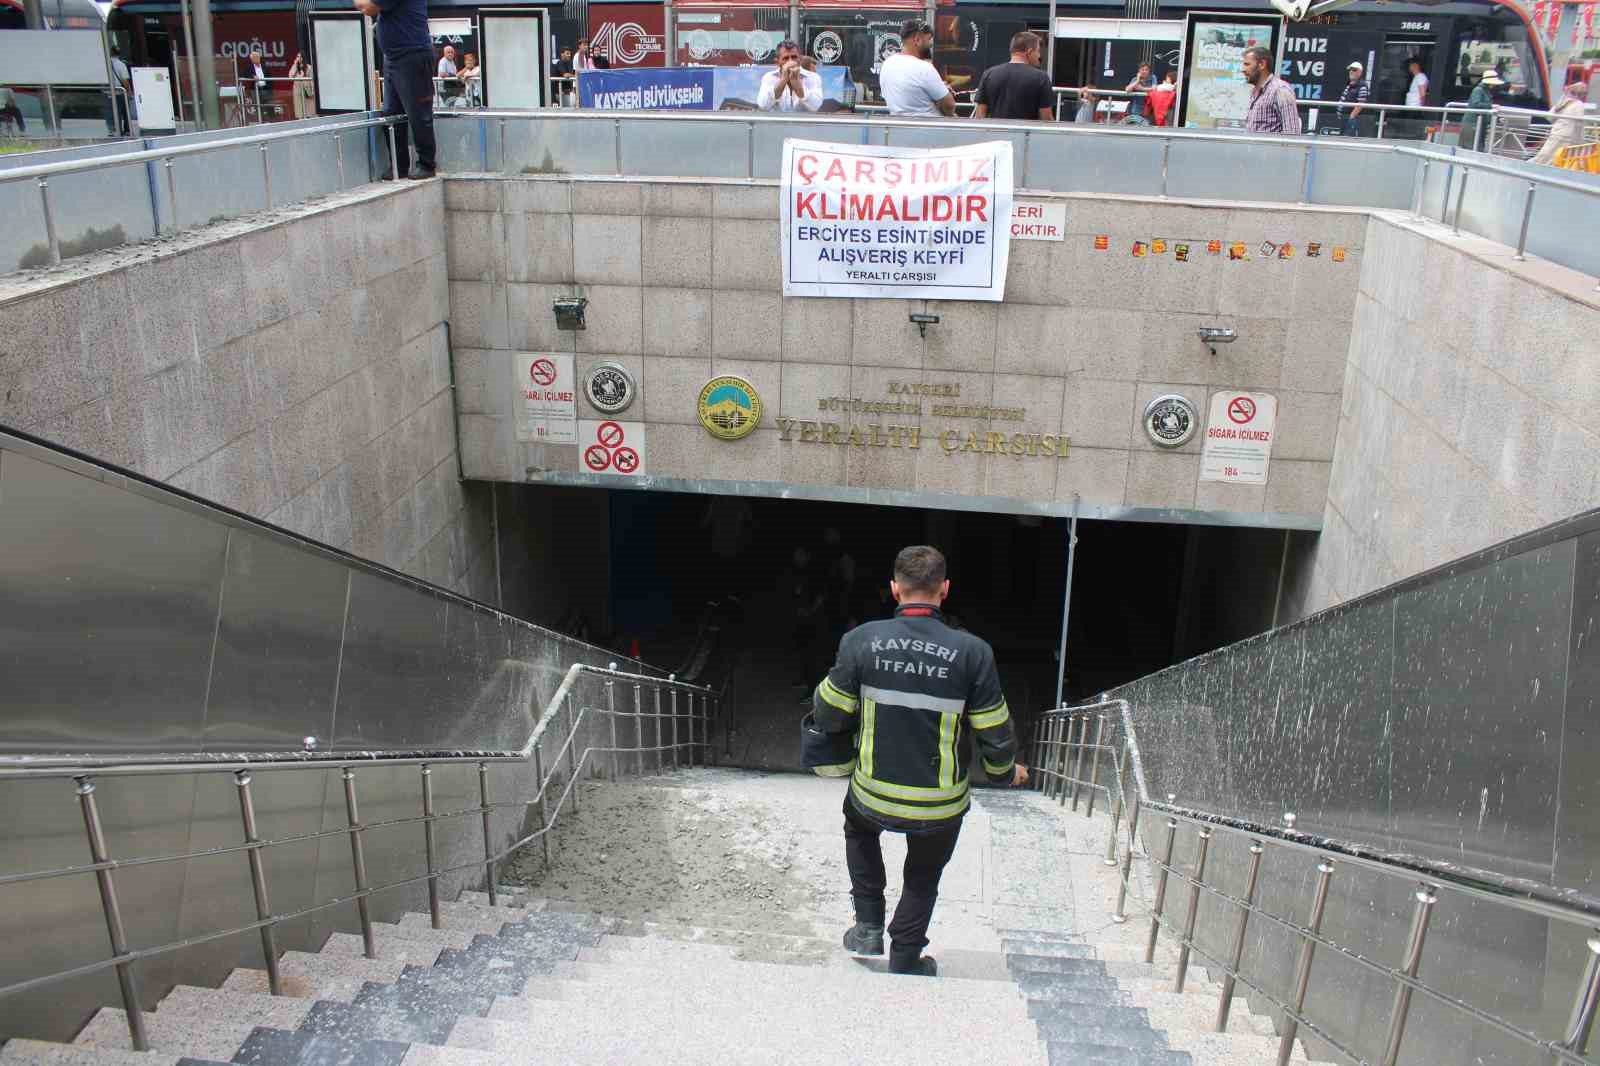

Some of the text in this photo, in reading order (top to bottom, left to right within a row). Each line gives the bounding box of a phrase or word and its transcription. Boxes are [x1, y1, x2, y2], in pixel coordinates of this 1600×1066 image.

[1296, 61, 1325, 76] ve
[594, 83, 704, 109] KAYSERİ BÜYÜKŞEHİR
[798, 154, 990, 188] ÇARŞIMIZ
[798, 225, 871, 243] ERCİYES
[818, 247, 964, 267] ALIŞVERİŞ KEYFİ
[846, 270, 937, 281] YERALTI ÇARŞISI
[775, 416, 920, 449] YERALTI
[1208, 427, 1236, 439] SİGARA
[1224, 466, 1239, 477] 184
[875, 655, 949, 678] İTFAİYE
